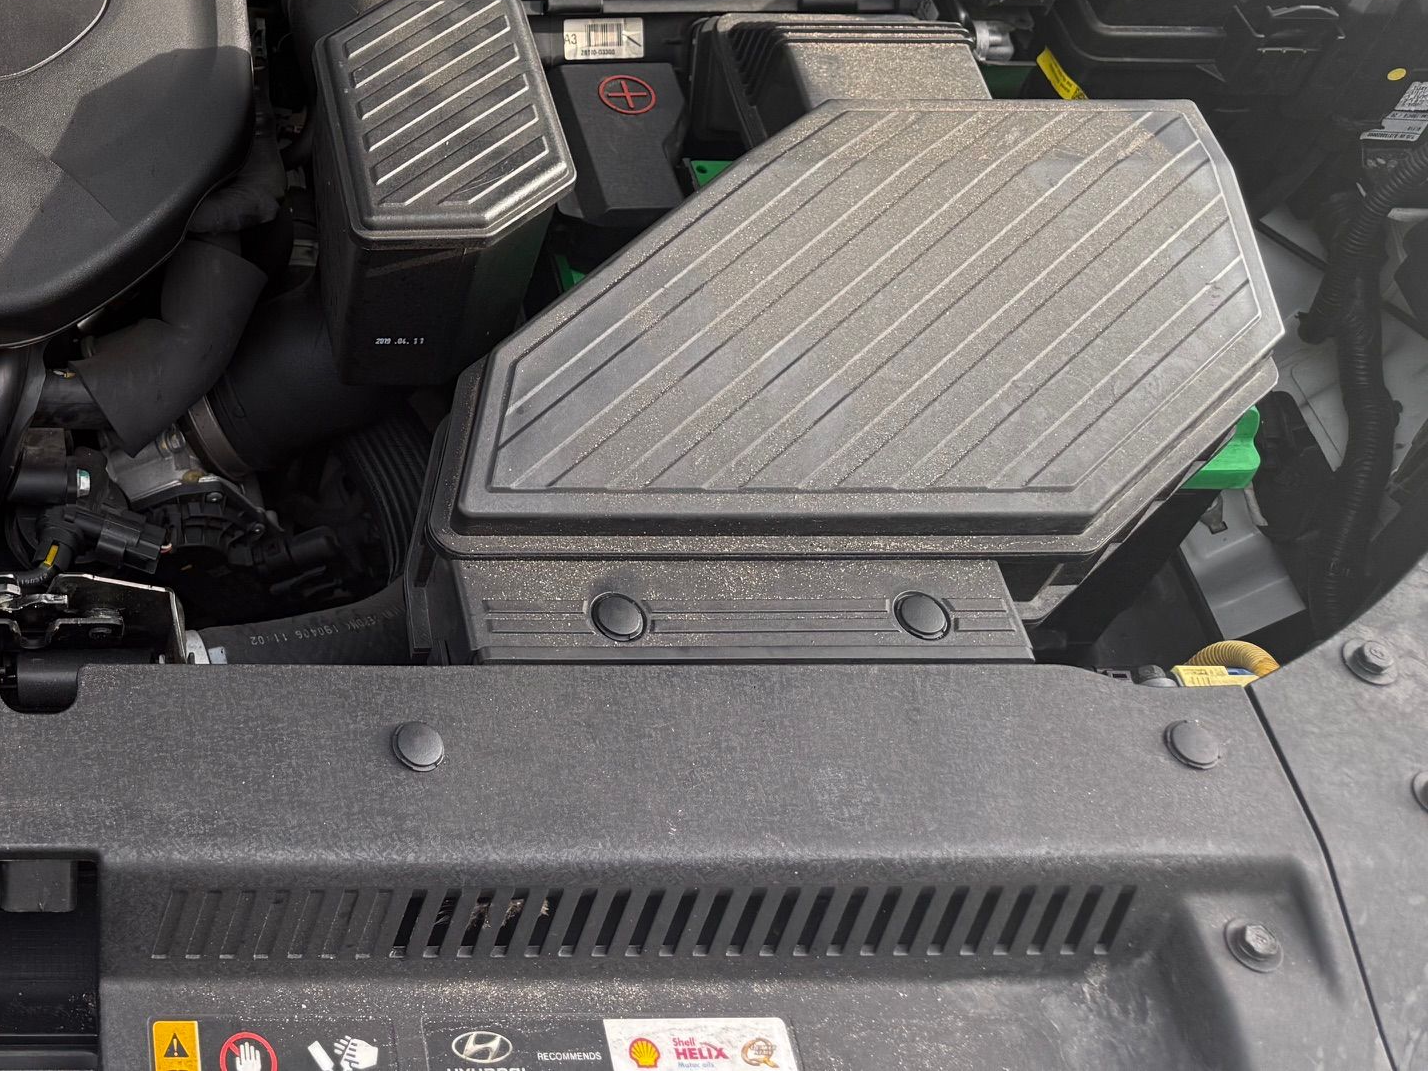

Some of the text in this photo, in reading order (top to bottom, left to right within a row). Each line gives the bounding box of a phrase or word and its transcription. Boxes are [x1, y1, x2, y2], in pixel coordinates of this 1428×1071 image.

[673, 1038, 695, 1047] Shell
[537, 1052, 602, 1061] RECOMMENDS
[674, 1046, 729, 1060] HELIX
